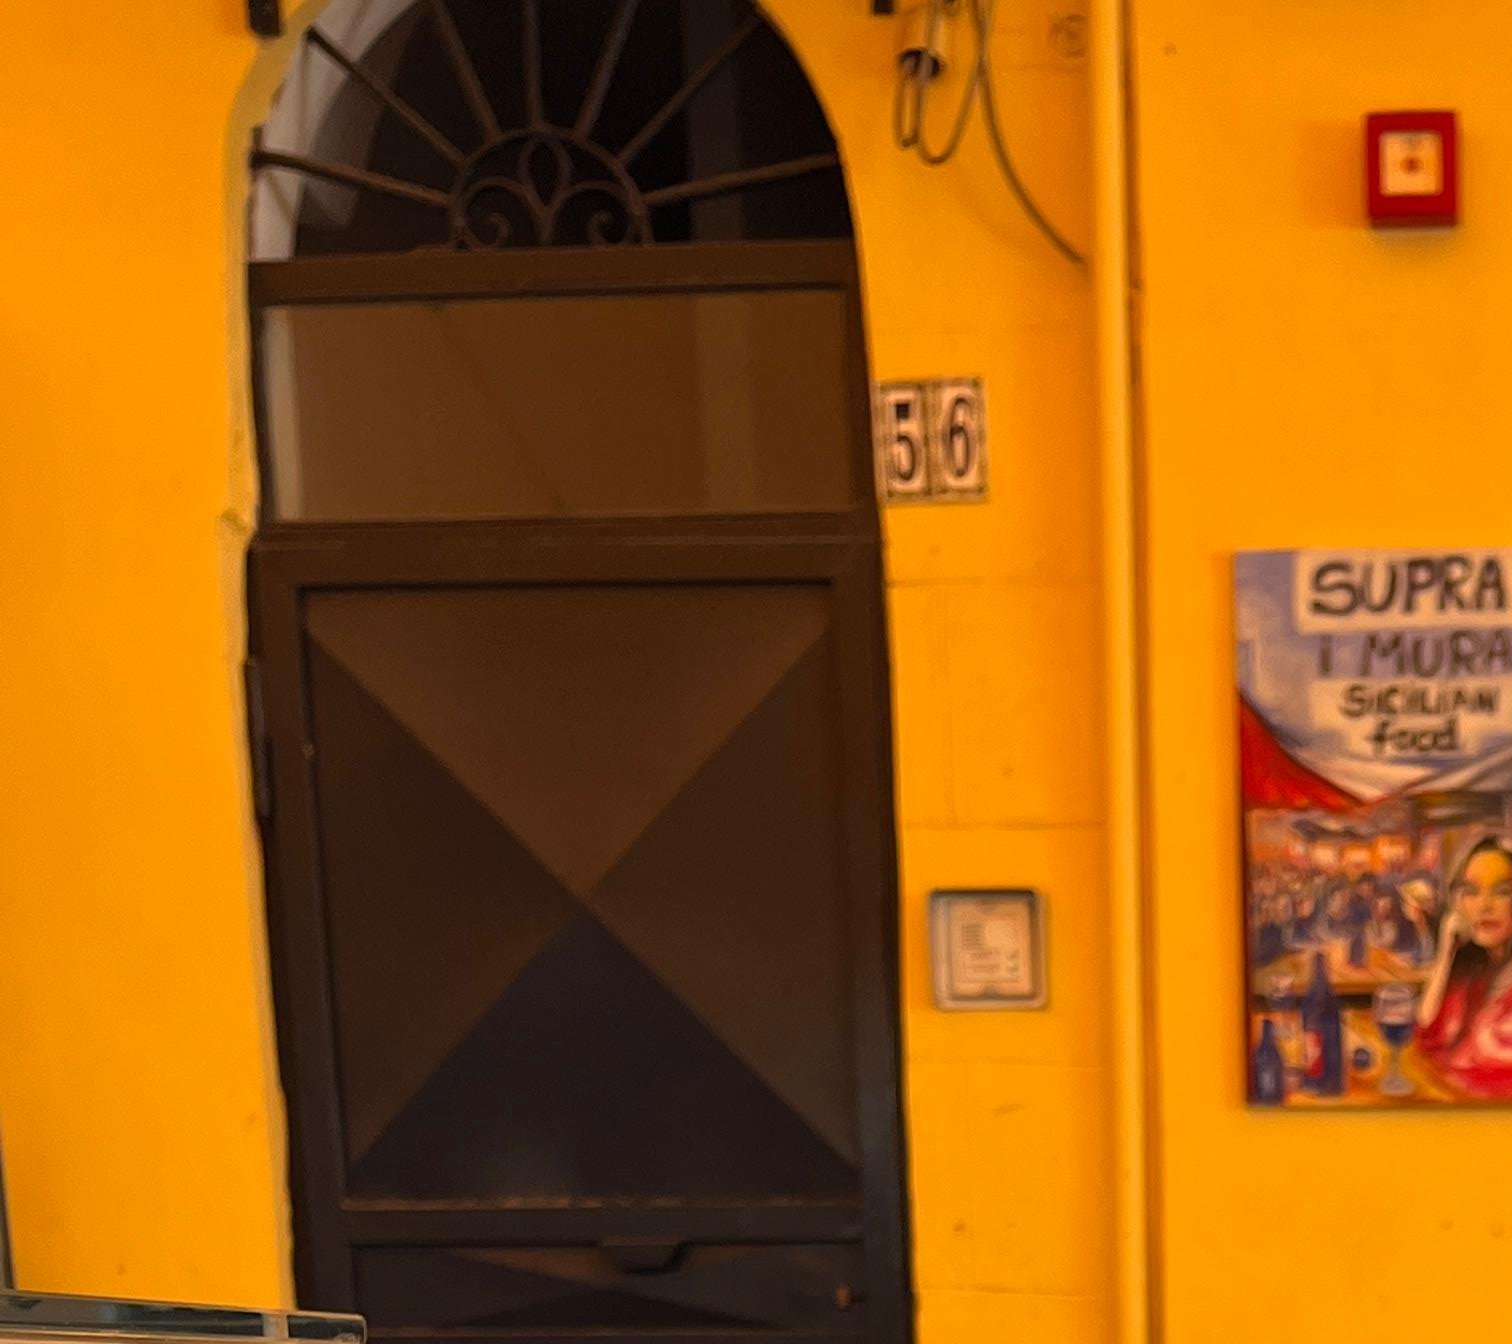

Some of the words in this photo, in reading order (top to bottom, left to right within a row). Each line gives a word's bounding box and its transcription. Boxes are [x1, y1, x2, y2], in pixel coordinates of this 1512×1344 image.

[887, 396, 974, 482] 56
[1310, 555, 1507, 617] SUPRA
[1318, 633, 1334, 677] I
[1339, 682, 1499, 718] SICILIAN
[1367, 717, 1459, 756] food
